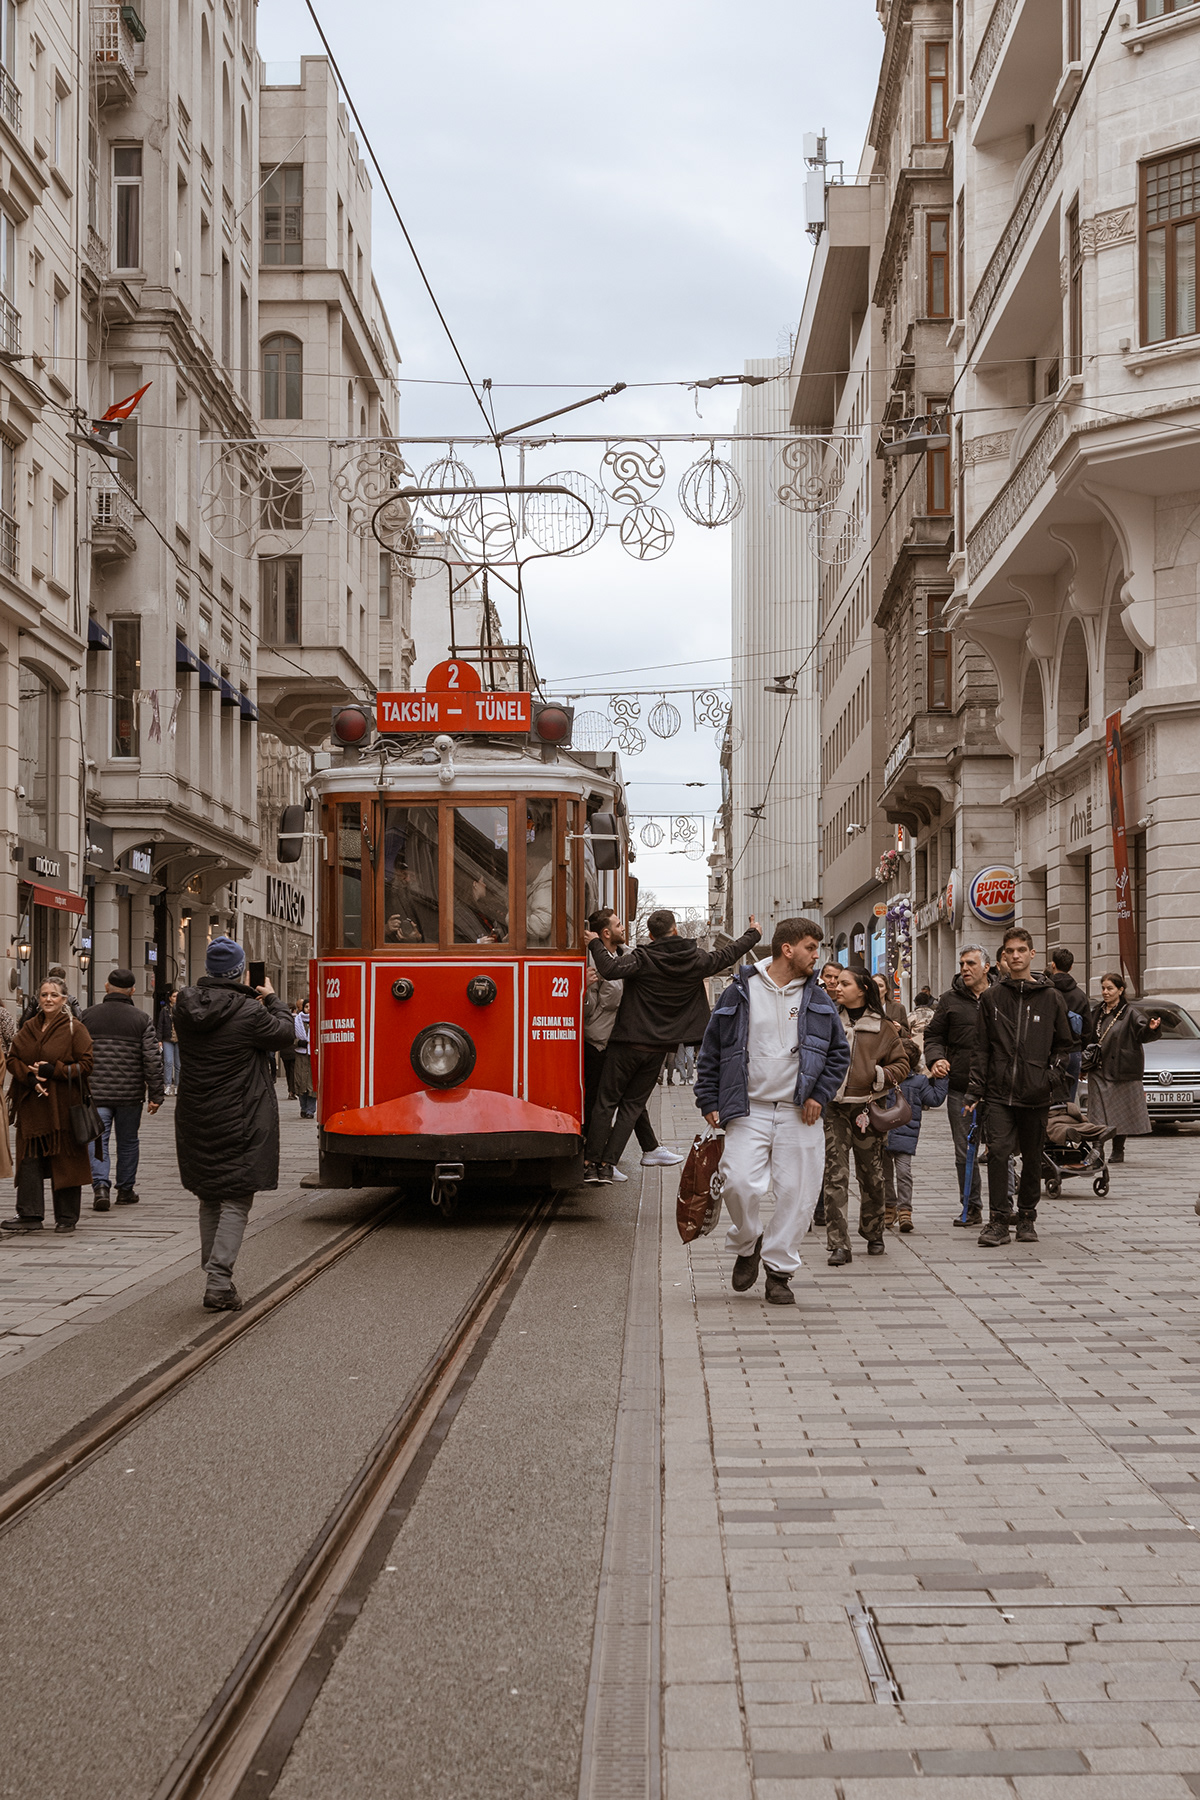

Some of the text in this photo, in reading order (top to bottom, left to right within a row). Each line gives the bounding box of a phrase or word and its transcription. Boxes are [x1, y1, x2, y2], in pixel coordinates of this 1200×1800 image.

[448, 664, 459, 688] 2
[382, 697, 439, 722] TAKSİM
[476, 695, 526, 721] TÜNEL
[35, 855, 61, 878] midpoint
[976, 880, 1016, 893] BURGE
[266, 875, 305, 927] MANGO
[326, 978, 340, 998] 223
[551, 977, 569, 998] 223
[334, 1018, 355, 1029] YASAK
[532, 1016, 561, 1027] ASILMAK
[532, 1029, 541, 1040] VE
[1146, 1093, 1191, 1102] 34 DTR 820
